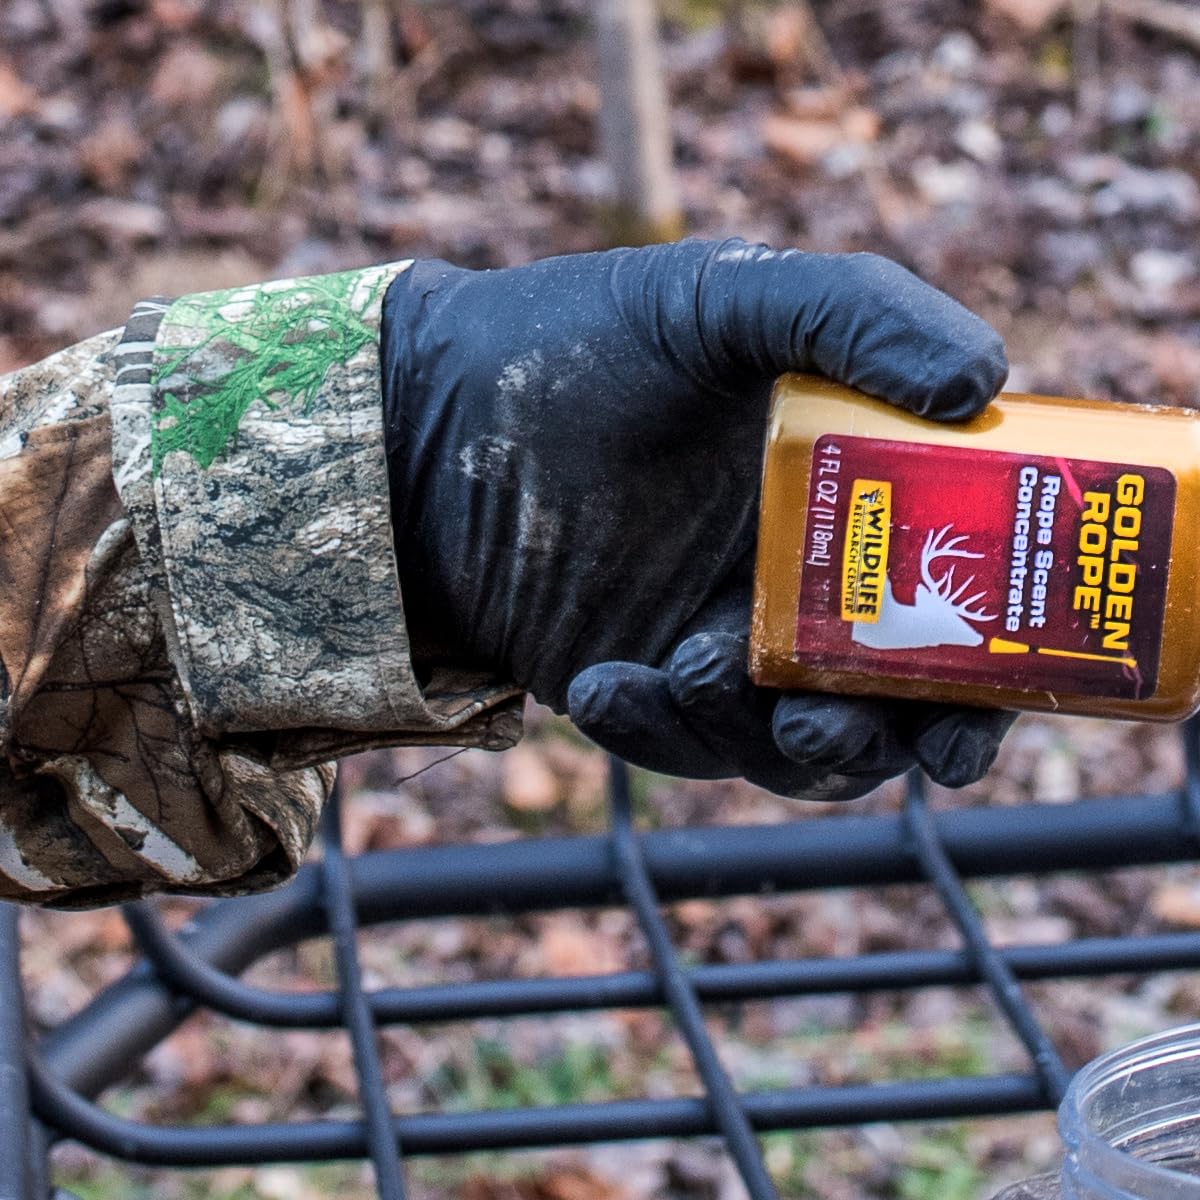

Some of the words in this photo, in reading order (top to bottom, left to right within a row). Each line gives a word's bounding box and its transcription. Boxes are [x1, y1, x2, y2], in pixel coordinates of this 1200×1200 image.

[819, 459, 840, 476] FL
[821, 444, 841, 454] 4
[816, 480, 839, 505] OZ
[1036, 475, 1061, 545] Rope
[805, 507, 835, 567] (118mL)
[849, 504, 862, 564] RESEARCH
[857, 507, 885, 615] WILDLIFE
[1005, 466, 1039, 632] Concentrate
[1073, 491, 1111, 612] ROPE
[1102, 474, 1145, 650] GOLDEN
[1029, 550, 1053, 628] Scent
